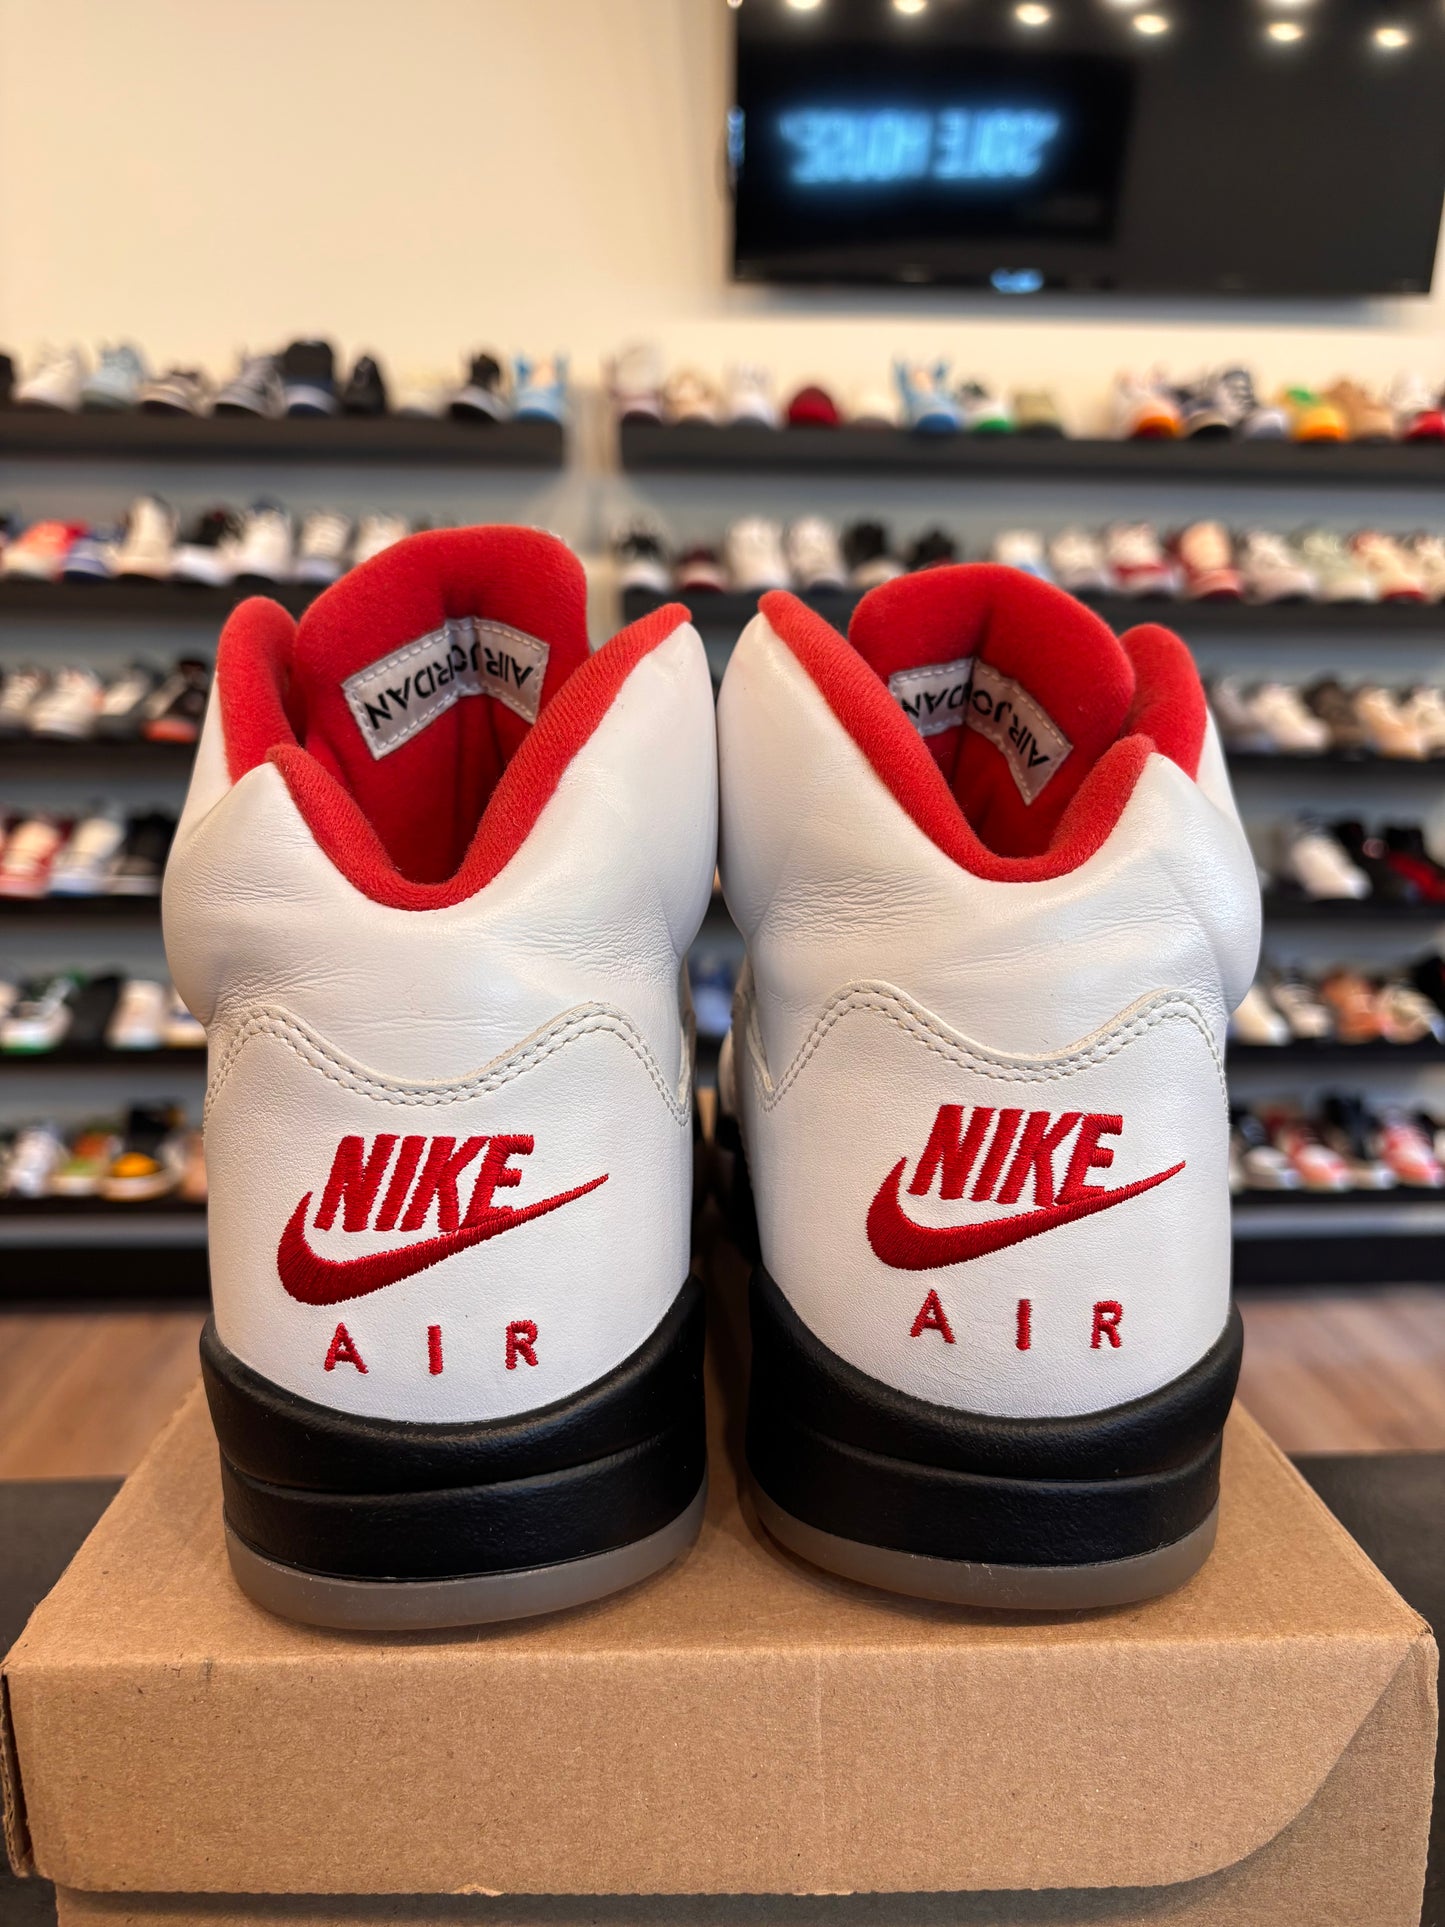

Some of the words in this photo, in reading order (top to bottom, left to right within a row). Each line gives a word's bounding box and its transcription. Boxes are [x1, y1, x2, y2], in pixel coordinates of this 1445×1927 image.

[484, 647, 533, 690] AIR
[901, 681, 1012, 722] JODAN
[1008, 713, 1050, 768] AIR
[313, 1133, 535, 1232] NIKE
[906, 1104, 1124, 1208] NIKE
[324, 1320, 539, 1376] AIR
[909, 1289, 1124, 1351] AIR
